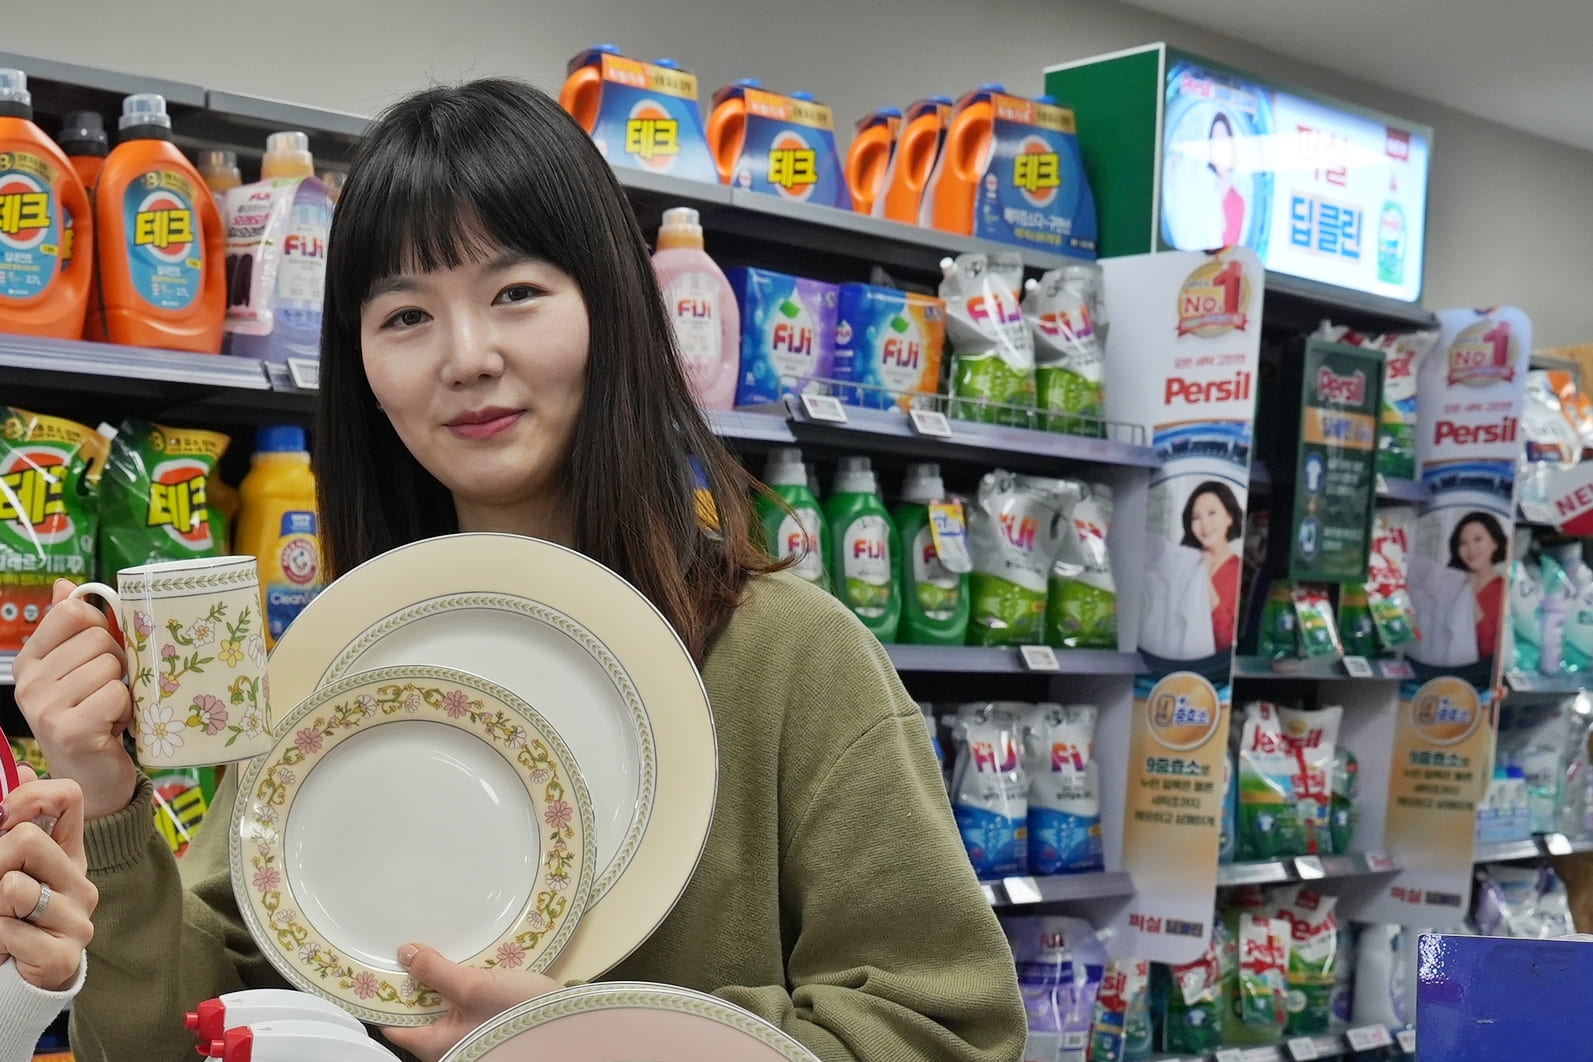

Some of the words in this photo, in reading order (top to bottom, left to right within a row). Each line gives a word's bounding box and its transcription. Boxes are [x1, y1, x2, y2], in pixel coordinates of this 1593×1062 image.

[624, 118, 682, 157] 테크
[768, 148, 819, 188] 테크
[1013, 152, 1062, 190] 테크
[133, 209, 194, 249] 테크
[1291, 194, 1363, 260] 딥클린
[1164, 370, 1252, 406] Persil
[1318, 365, 1366, 404] Persil
[1433, 416, 1518, 446] Persil
[1128, 913, 1163, 934] 퍼실
